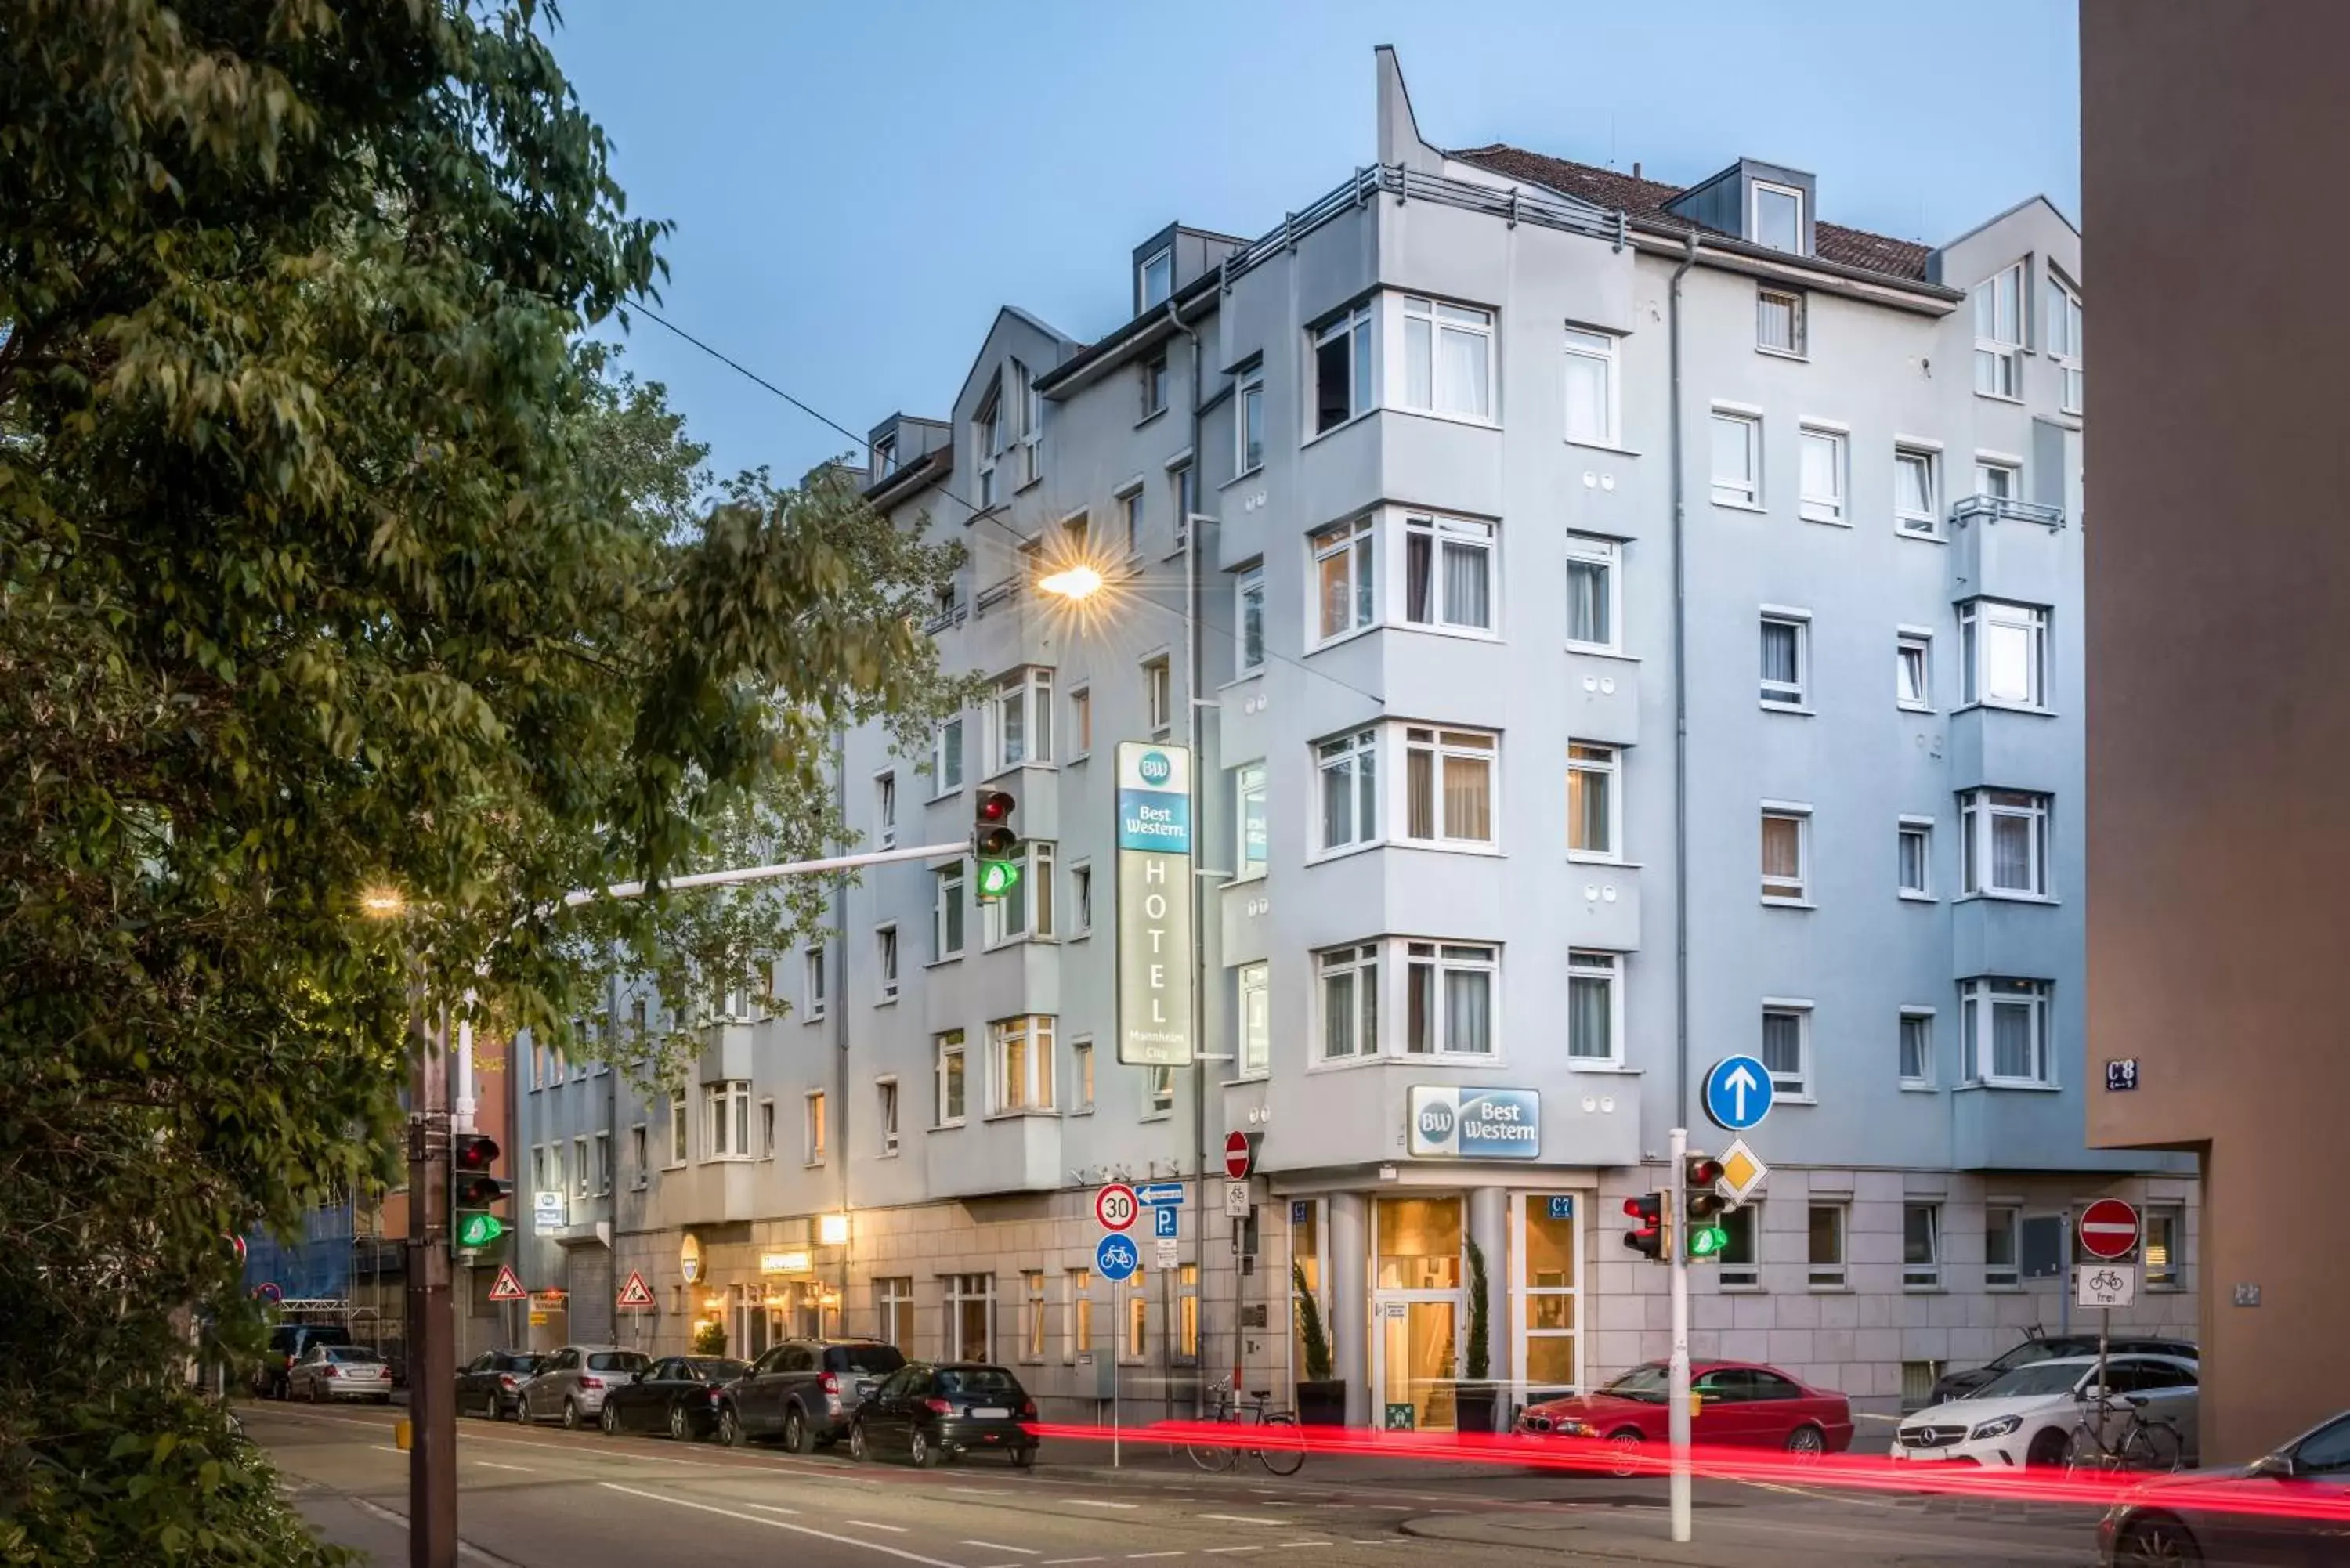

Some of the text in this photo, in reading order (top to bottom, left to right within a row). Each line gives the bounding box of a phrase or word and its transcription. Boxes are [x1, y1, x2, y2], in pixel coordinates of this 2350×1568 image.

[1143, 761, 1168, 778] BW
[1140, 806, 1172, 822] Best
[1145, 859, 1166, 1023] HOTEL
[1129, 1028, 1184, 1042] Mannheim
[1481, 1102, 1520, 1121] Best
[1422, 1113, 1452, 1132] BW
[1464, 1121, 1535, 1140] Western
[1105, 1198, 1130, 1218] 30
[1159, 1210, 1172, 1234] P
[2097, 1292, 2117, 1302] frei
